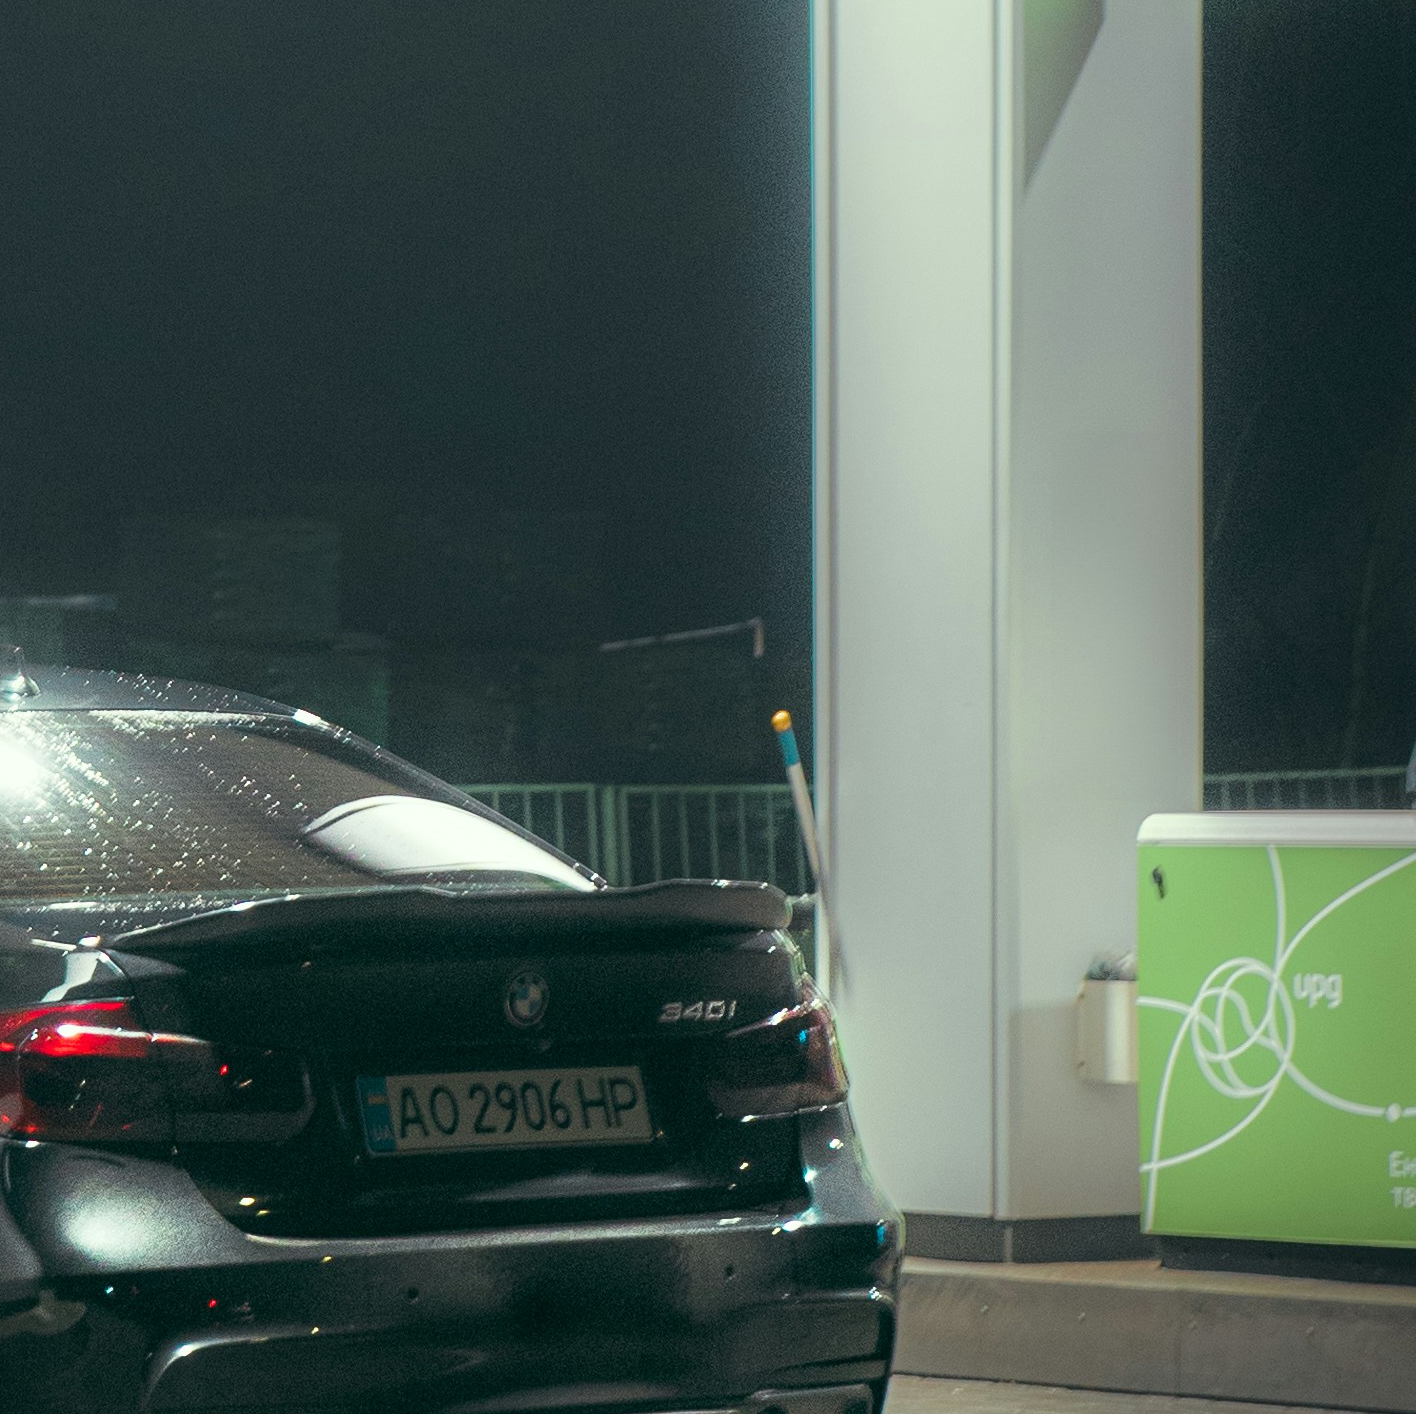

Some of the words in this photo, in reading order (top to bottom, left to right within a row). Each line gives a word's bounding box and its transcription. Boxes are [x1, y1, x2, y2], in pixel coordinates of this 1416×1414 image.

[1293, 973, 1344, 1009] upg
[399, 1084, 461, 1138] AO
[468, 1078, 573, 1135] 2906
[575, 1075, 639, 1130] HP
